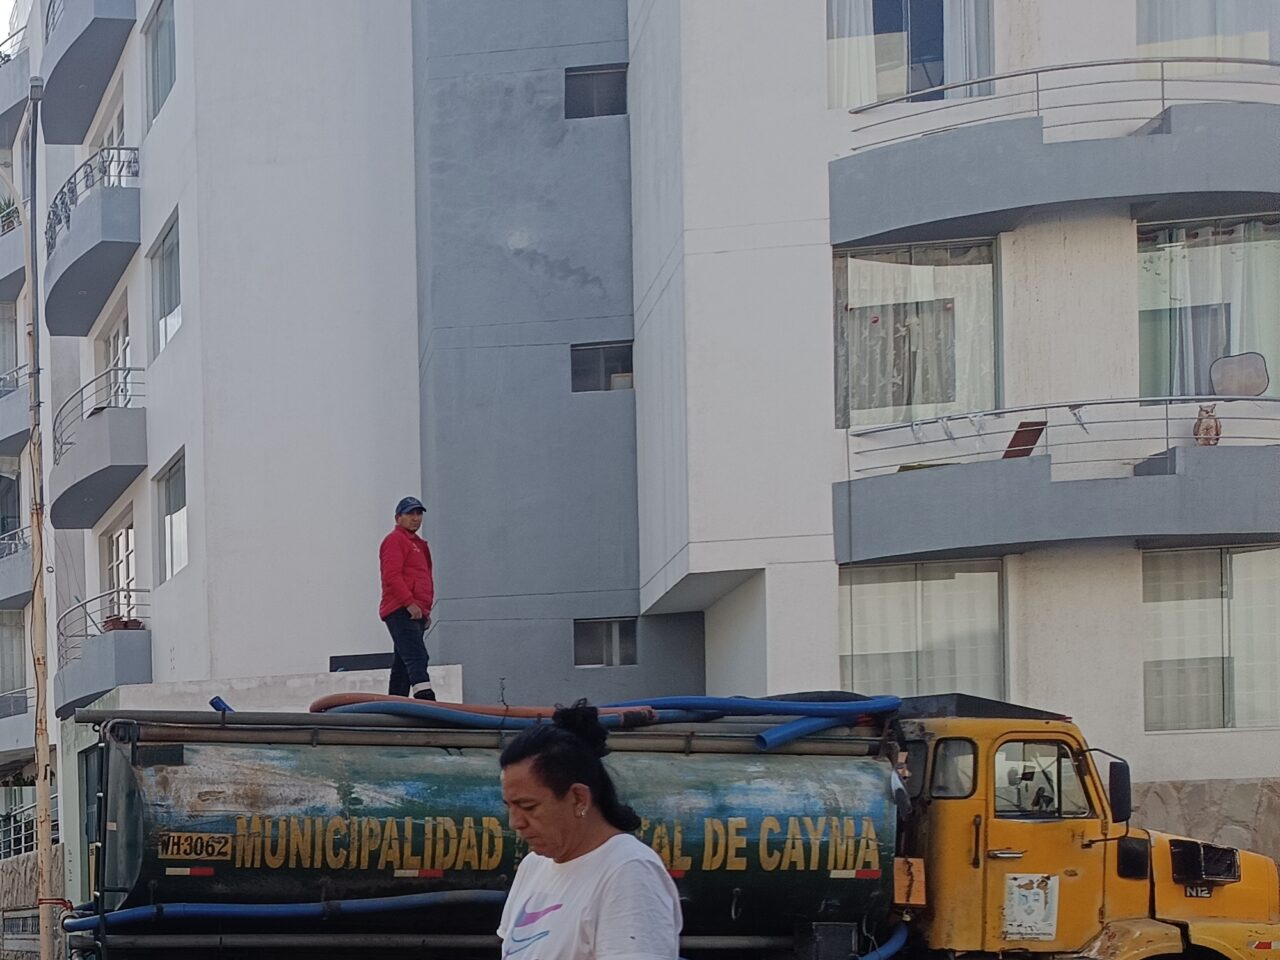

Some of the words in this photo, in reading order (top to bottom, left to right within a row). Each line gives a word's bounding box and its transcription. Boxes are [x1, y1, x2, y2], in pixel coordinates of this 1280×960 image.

[235, 815, 504, 871] MUNICIPALIDAD
[702, 816, 748, 871] DE
[758, 816, 881, 872] CAYMA
[1186, 886, 1211, 898] N12
